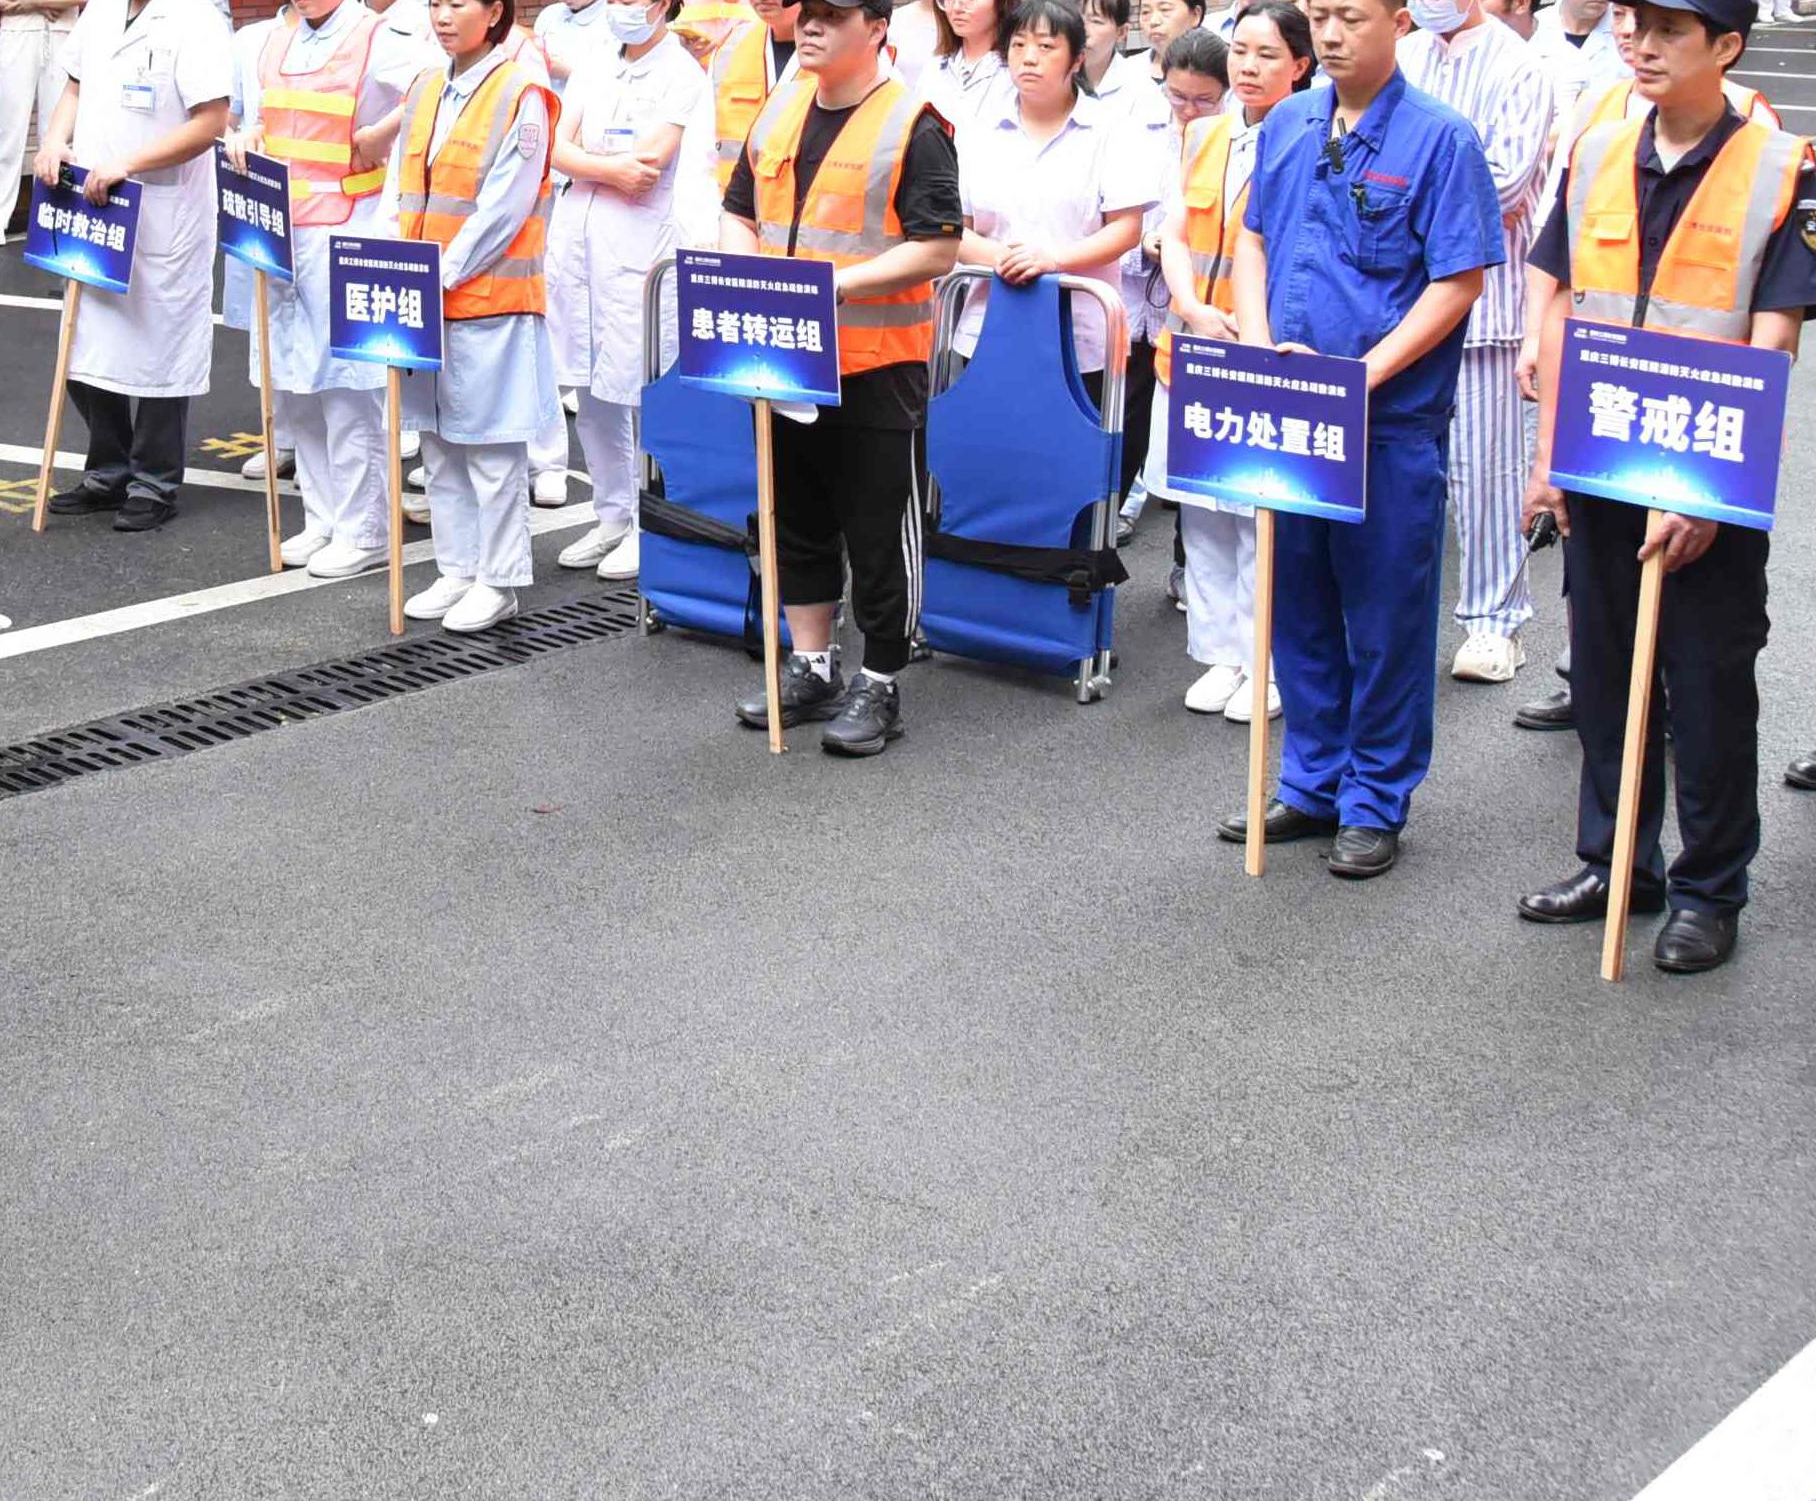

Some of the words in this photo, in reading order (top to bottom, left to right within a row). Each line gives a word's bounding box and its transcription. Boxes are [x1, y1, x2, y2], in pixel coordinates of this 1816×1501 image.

[37, 201, 127, 252] 临时救治组
[345, 282, 424, 329] 医护组
[692, 307, 823, 352] 患者转运组
[1184, 401, 1346, 462] 电力处置组
[1589, 381, 1745, 463] 警戒组
